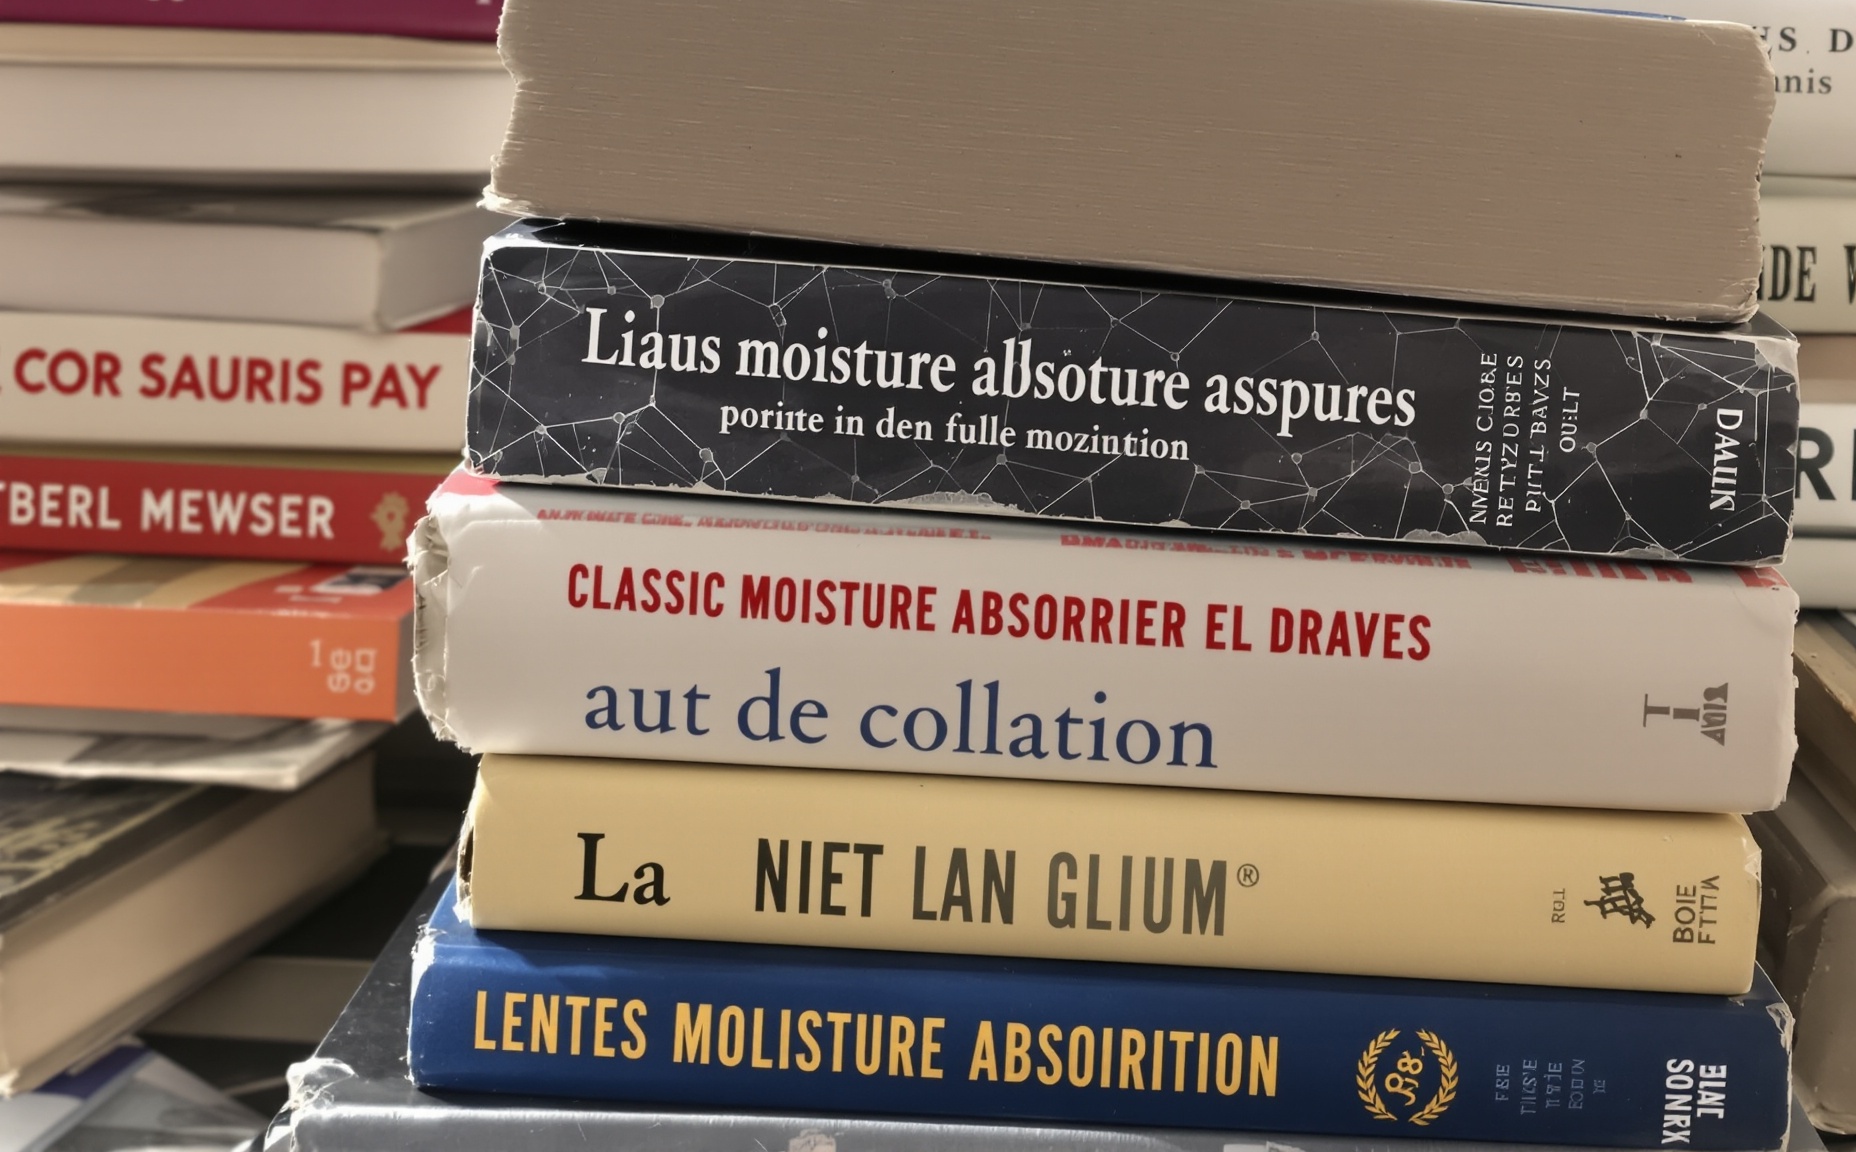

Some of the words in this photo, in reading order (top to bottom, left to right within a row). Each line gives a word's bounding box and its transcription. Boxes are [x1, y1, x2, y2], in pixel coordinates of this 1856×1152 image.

[14, 348, 122, 397] COR
[140, 353, 323, 405] SAURIS
[341, 362, 441, 409] PAY
[581, 307, 721, 375] Liaus
[735, 327, 957, 394] moisture
[1203, 373, 1416, 438] asspures
[834, 405, 865, 436] in
[876, 407, 935, 441] den
[945, 413, 1016, 447] fulle
[1026, 425, 1190, 461] mozintion
[1795, 427, 1856, 500] R
[0, 482, 121, 530] BERL
[141, 489, 334, 538] MEWSER
[568, 564, 725, 618] CLASSIC
[739, 575, 936, 632] MOISTURE
[952, 590, 1186, 648] ABSORRIER
[1205, 604, 1253, 651] EL
[1270, 607, 1432, 662] DRAVES
[584, 681, 711, 736] aut
[737, 667, 830, 743] de
[859, 679, 1219, 770] collation
[574, 832, 671, 907] La
[755, 837, 885, 918] NIET
[912, 845, 1017, 925] LAN
[474, 990, 648, 1059] LENTES
[673, 1002, 945, 1079] MOLISTURE
[968, 1020, 1280, 1097] ABSOIRITION
